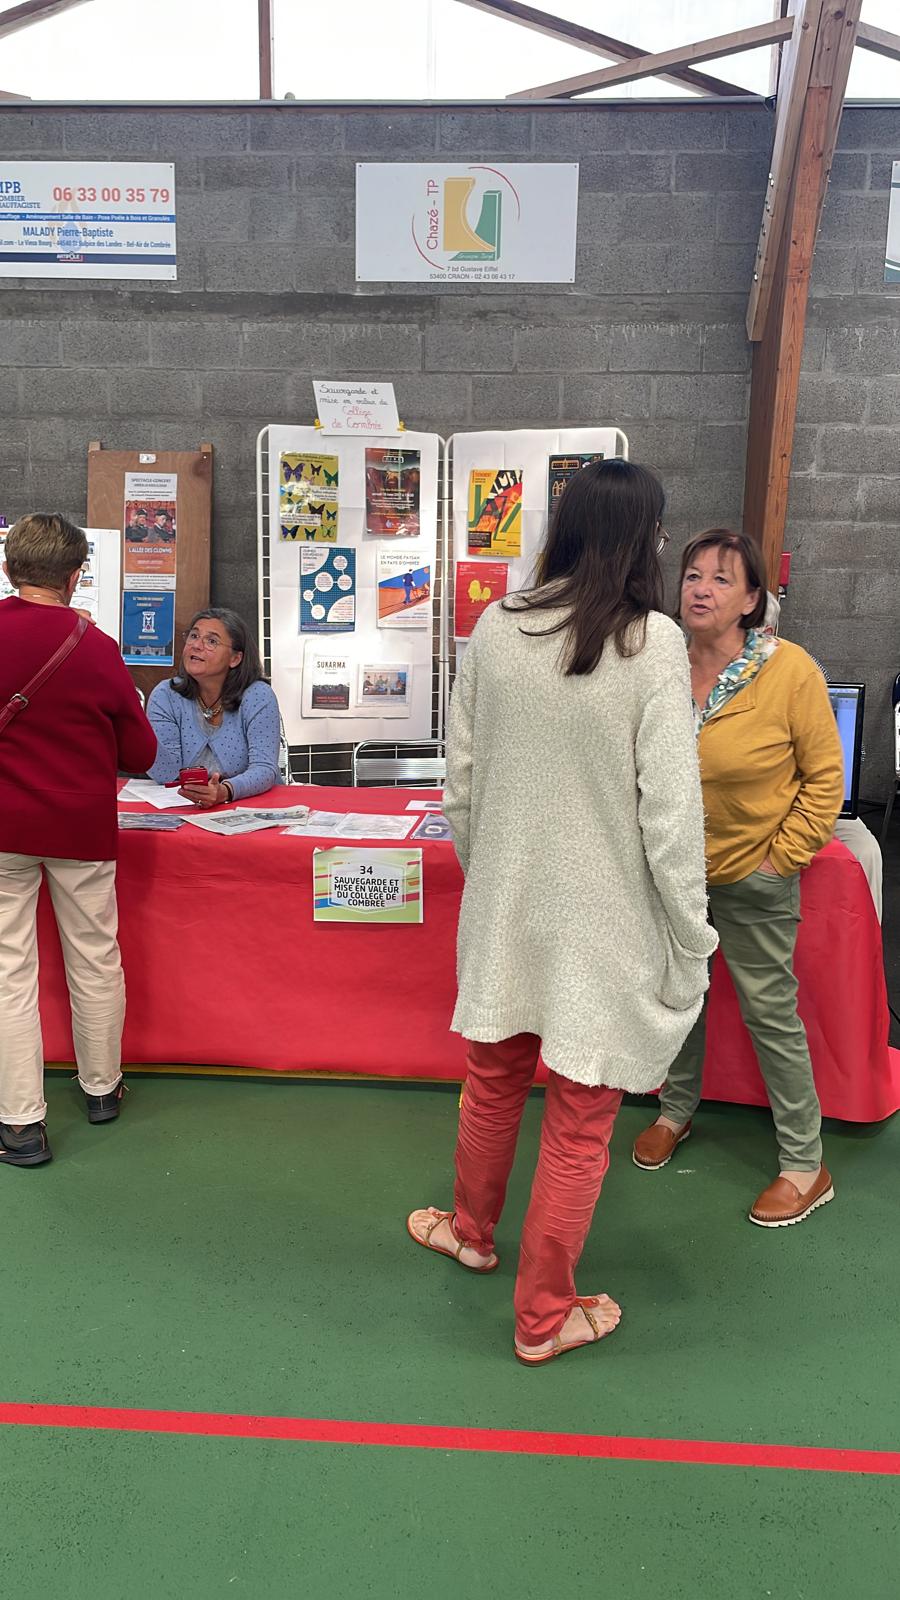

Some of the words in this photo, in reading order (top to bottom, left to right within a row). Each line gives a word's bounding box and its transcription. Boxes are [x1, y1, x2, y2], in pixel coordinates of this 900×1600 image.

[427, 179, 439, 196] TP
[53, 187, 72, 201] 06
[77, 187, 97, 202] 33
[101, 187, 121, 202] 00
[126, 188, 145, 202] 35
[150, 188, 170, 203] 79
[23, 227, 55, 237] MALADY
[57, 227, 114, 239] Pierre-Baptiste
[427, 209, 439, 250] Chazé
[319, 396, 340, 404] mise
[316, 661, 346, 669] SUKARMA
[360, 865, 373, 874] 34
[334, 876, 387, 886] SAUVEGARDE
[389, 879, 399, 887] ET
[334, 884, 353, 892] MISE
[355, 884, 366, 892] EN
[368, 885, 399, 893] VALEUR
[337, 891, 348, 899] DU
[386, 893, 397, 901] DE
